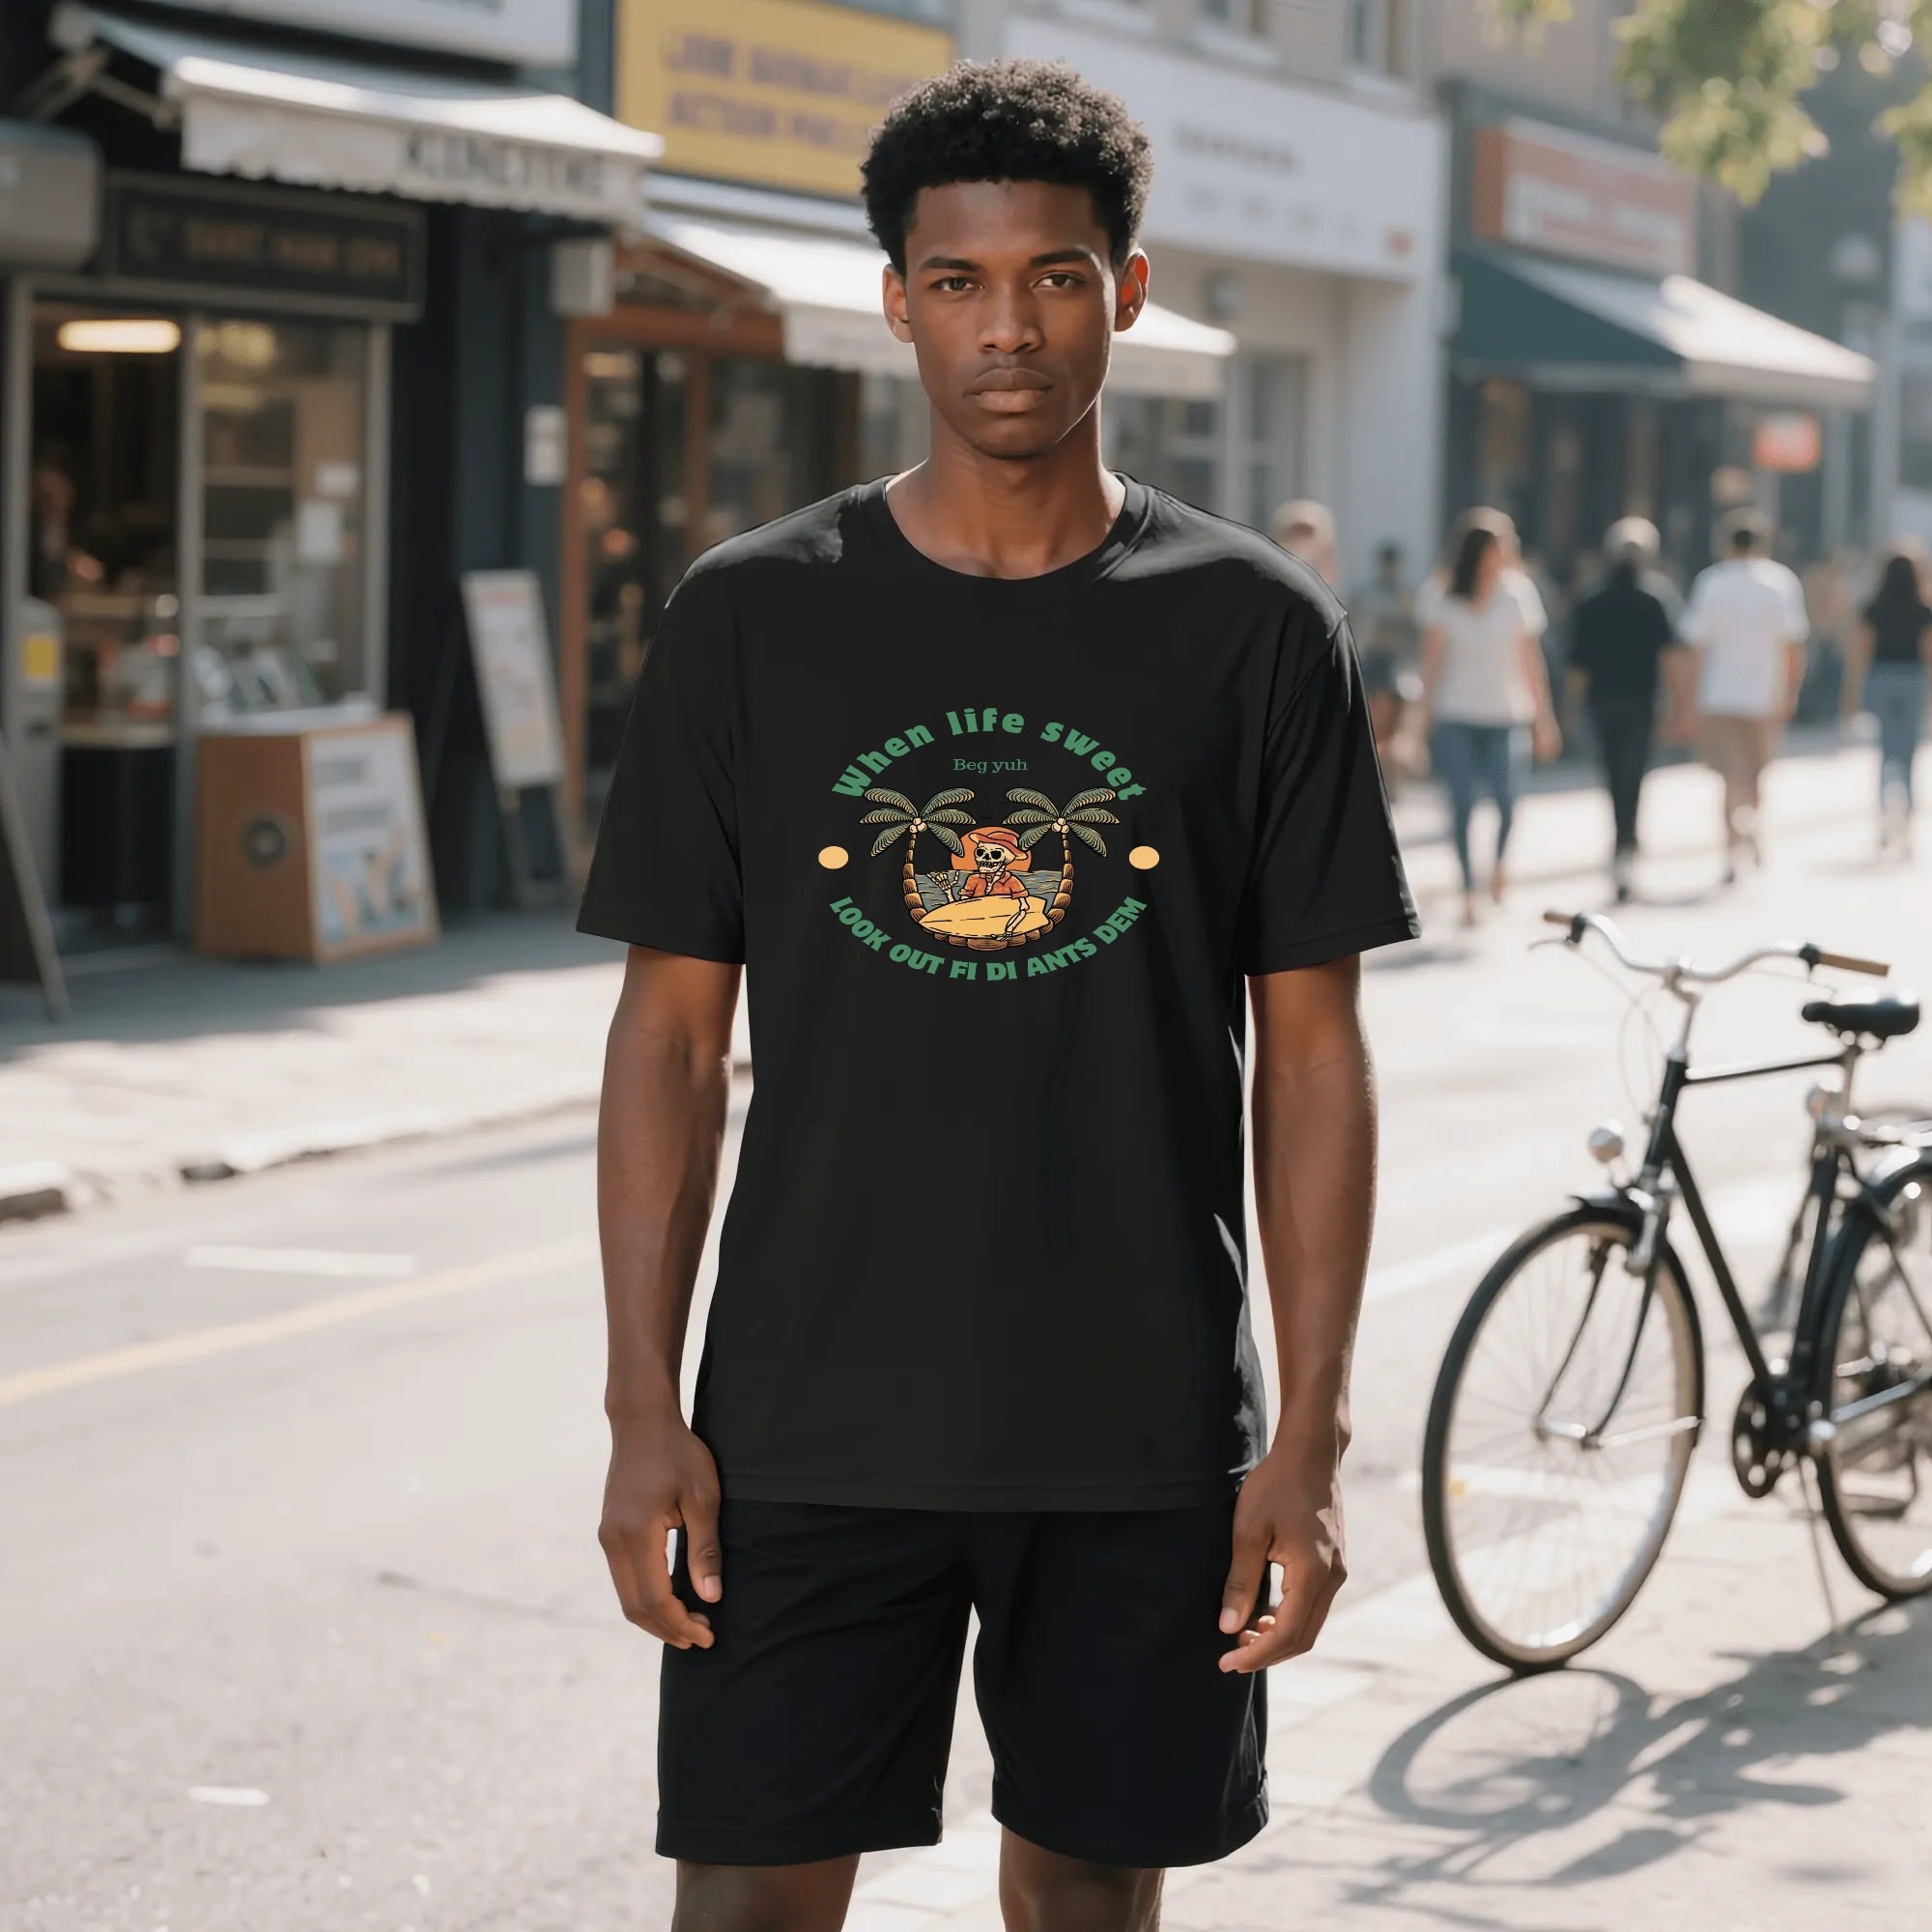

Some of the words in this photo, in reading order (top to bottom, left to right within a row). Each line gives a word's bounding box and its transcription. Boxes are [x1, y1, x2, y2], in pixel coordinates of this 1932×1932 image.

[832, 724, 934, 798] When
[946, 707, 1025, 736] life
[1040, 722, 1147, 801] sweet
[952, 758, 987, 774] Beg
[991, 758, 1028, 774] yuh
[830, 896, 892, 952] LOOK
[889, 943, 945, 975] OUT
[949, 960, 978, 980] FI
[986, 961, 1018, 981] DI
[1027, 938, 1097, 978] ANTS
[1093, 896, 1147, 945] DEM
